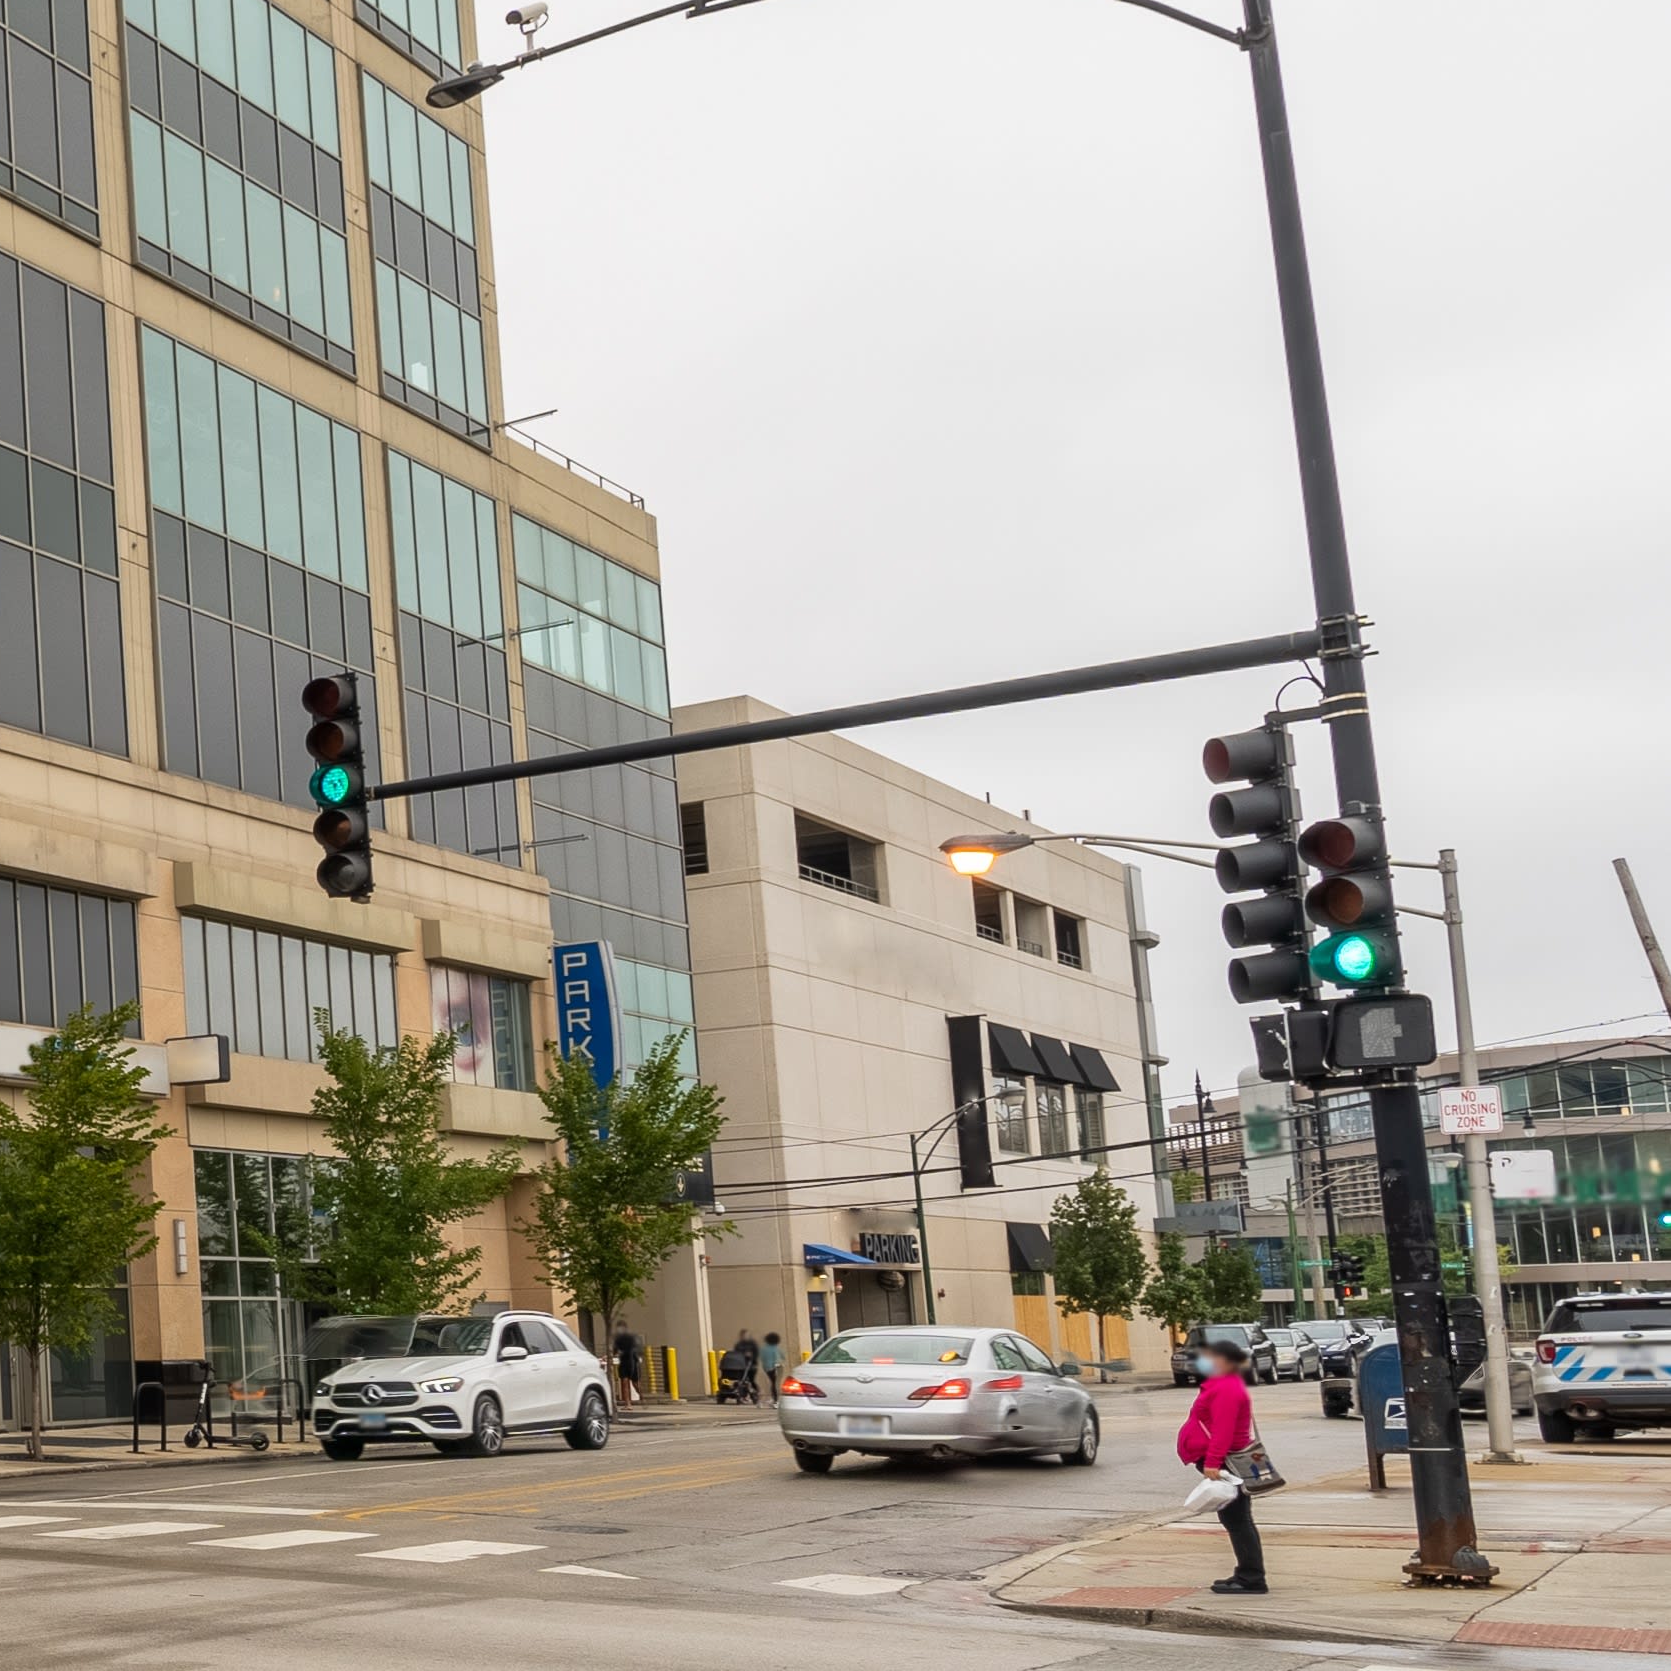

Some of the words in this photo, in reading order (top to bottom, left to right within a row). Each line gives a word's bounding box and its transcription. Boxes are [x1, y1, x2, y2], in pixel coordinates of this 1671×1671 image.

[1461, 1090, 1477, 1103] NO
[1444, 1103, 1496, 1116] CRUISING
[1457, 1116, 1486, 1128] ZONE
[864, 1234, 919, 1264] PARKING
